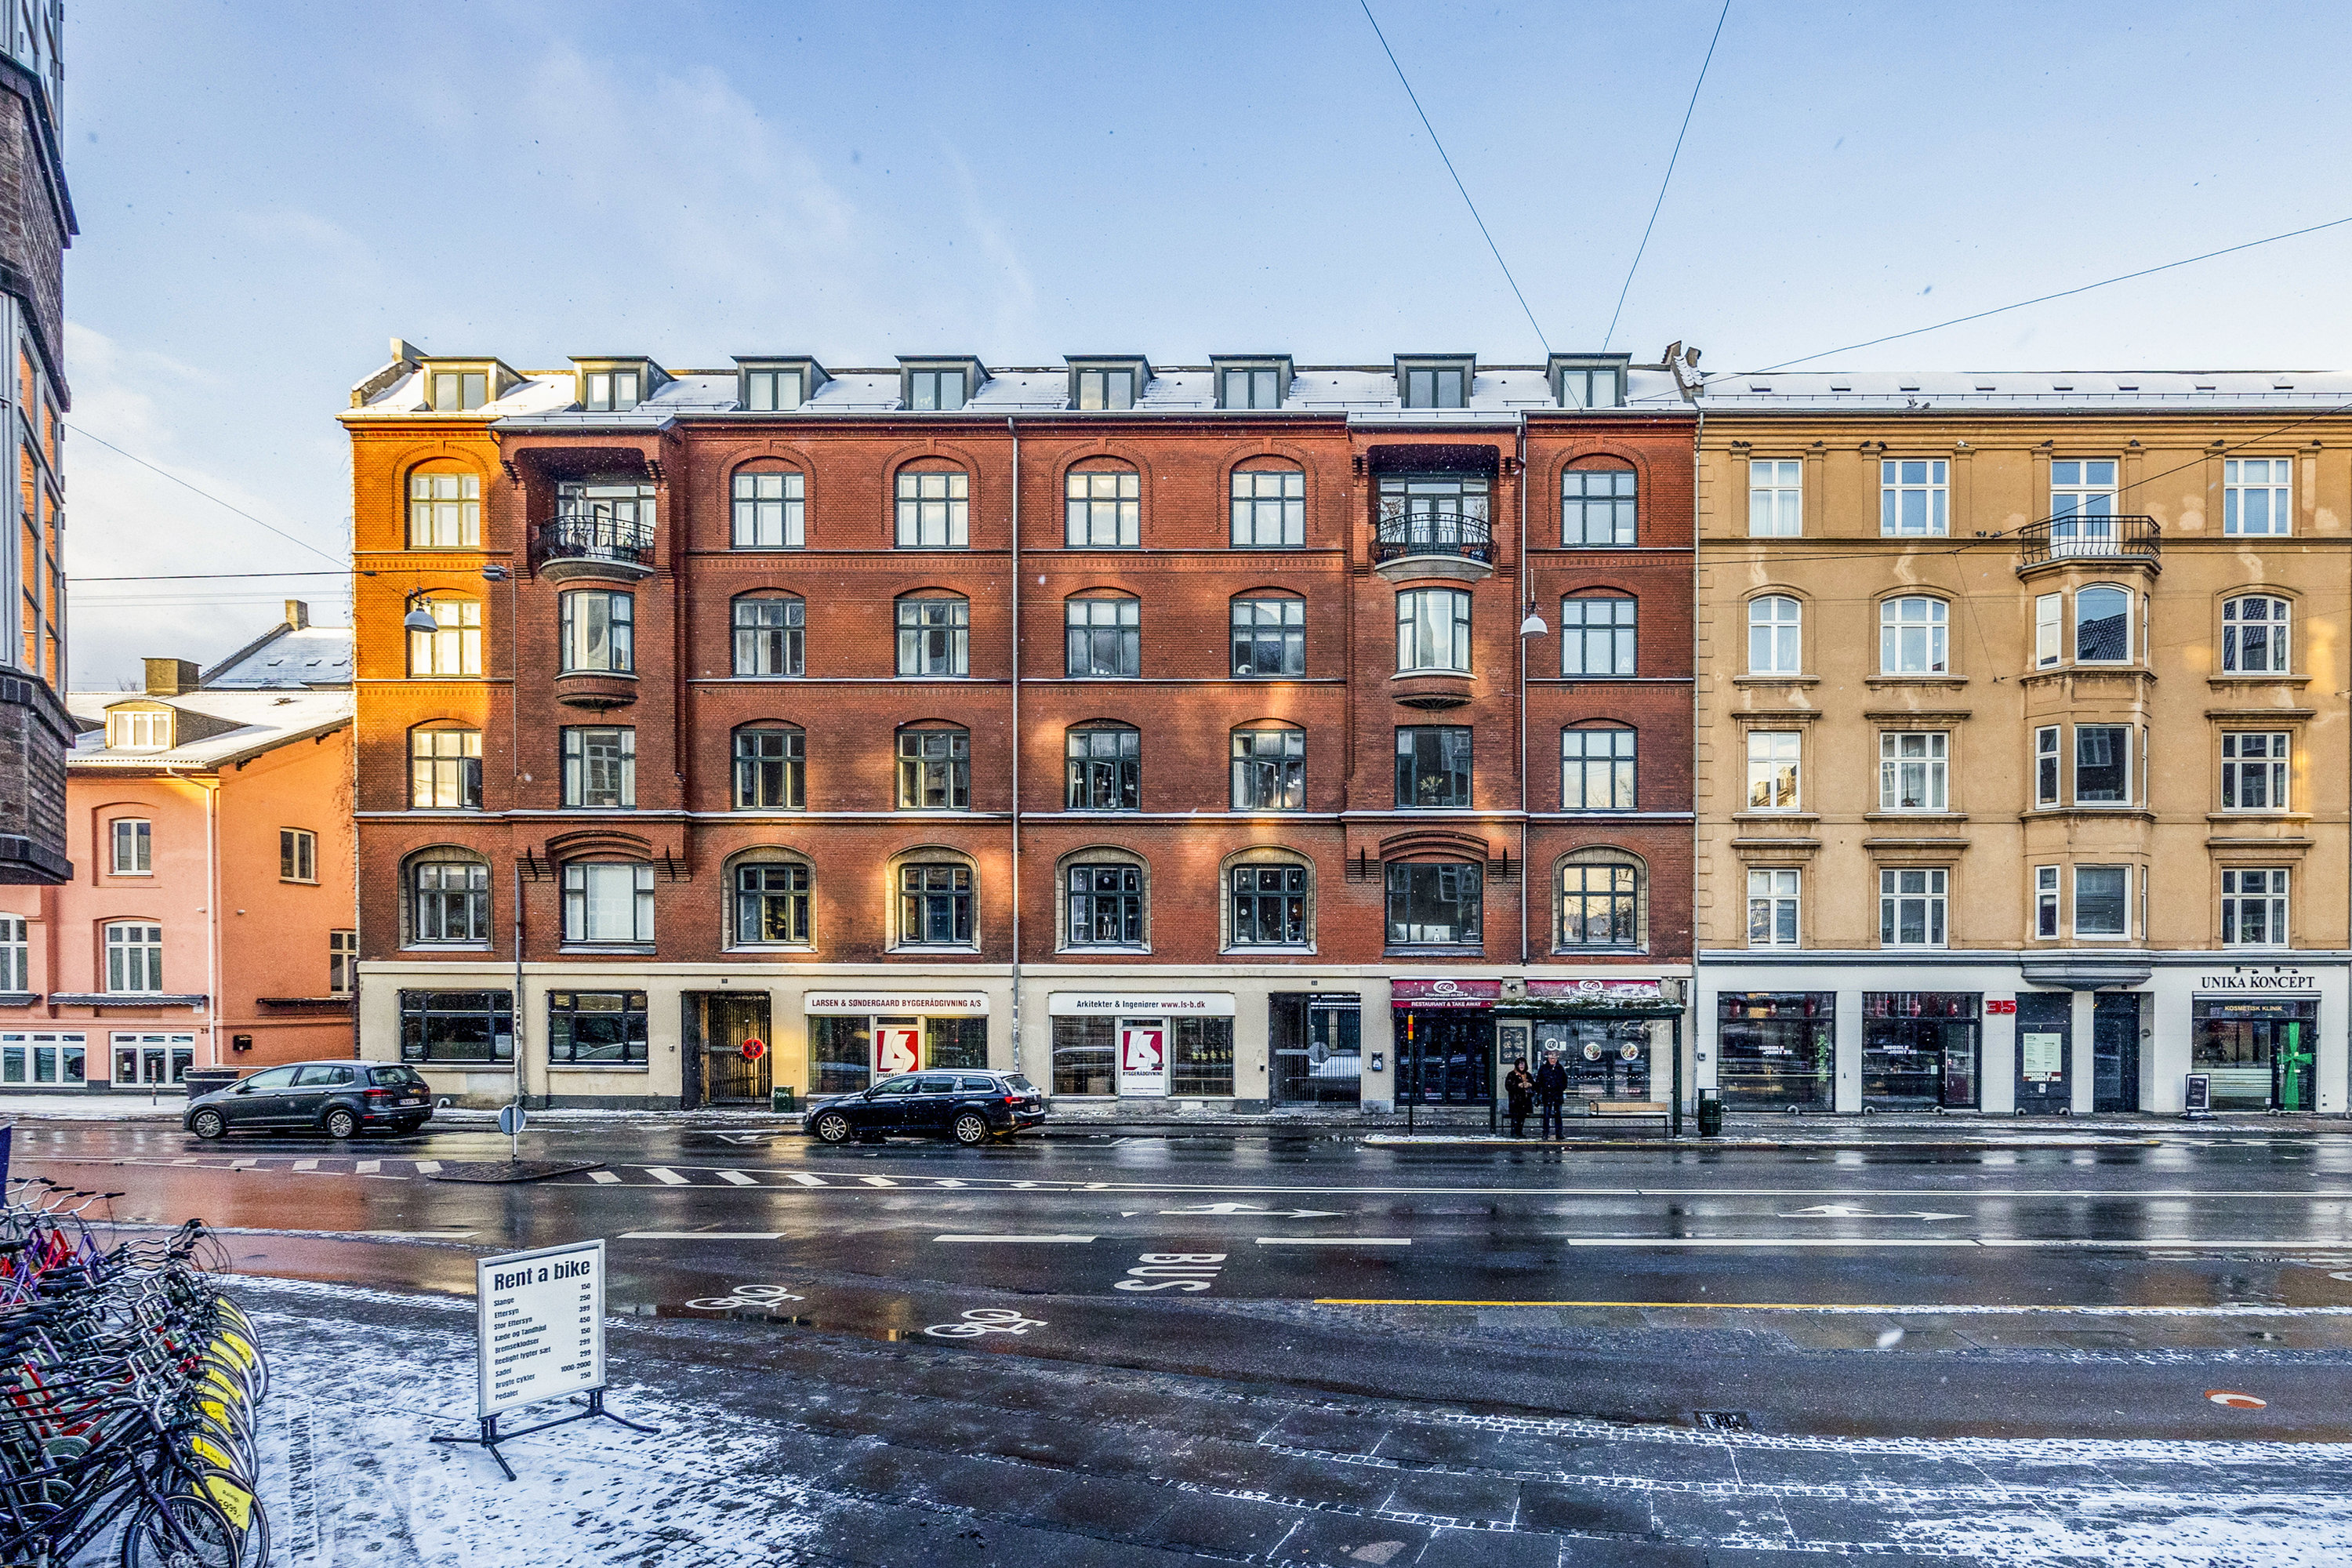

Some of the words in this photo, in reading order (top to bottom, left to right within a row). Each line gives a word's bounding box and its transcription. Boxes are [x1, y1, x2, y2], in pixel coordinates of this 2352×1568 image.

[2201, 977, 2245, 988] UNIKA
[2250, 977, 2314, 988] KONCEPT
[902, 998, 967, 1007] BYGGERÅDGIVNING
[1123, 1000, 1159, 1009] Ingeniører
[1985, 1000, 2016, 1014] 35
[494, 1267, 533, 1291] Rent
[538, 1267, 548, 1283] a
[554, 1260, 590, 1279] bike
[1113, 1253, 1228, 1292] BUS
[494, 1298, 514, 1306] Slange
[495, 1308, 519, 1319] Eftersyn
[508, 1317, 532, 1327] Eftersyn
[495, 1333, 511, 1341] Kæde
[522, 1325, 547, 1335] Tandhjul
[495, 1338, 539, 1353] Bremseklodser
[521, 1350, 538, 1359] lygter
[495, 1378, 514, 1389] Brugte
[516, 1374, 535, 1383] cykler
[561, 1360, 591, 1372] 1000-2000
[495, 1389, 518, 1400] Pedaler
